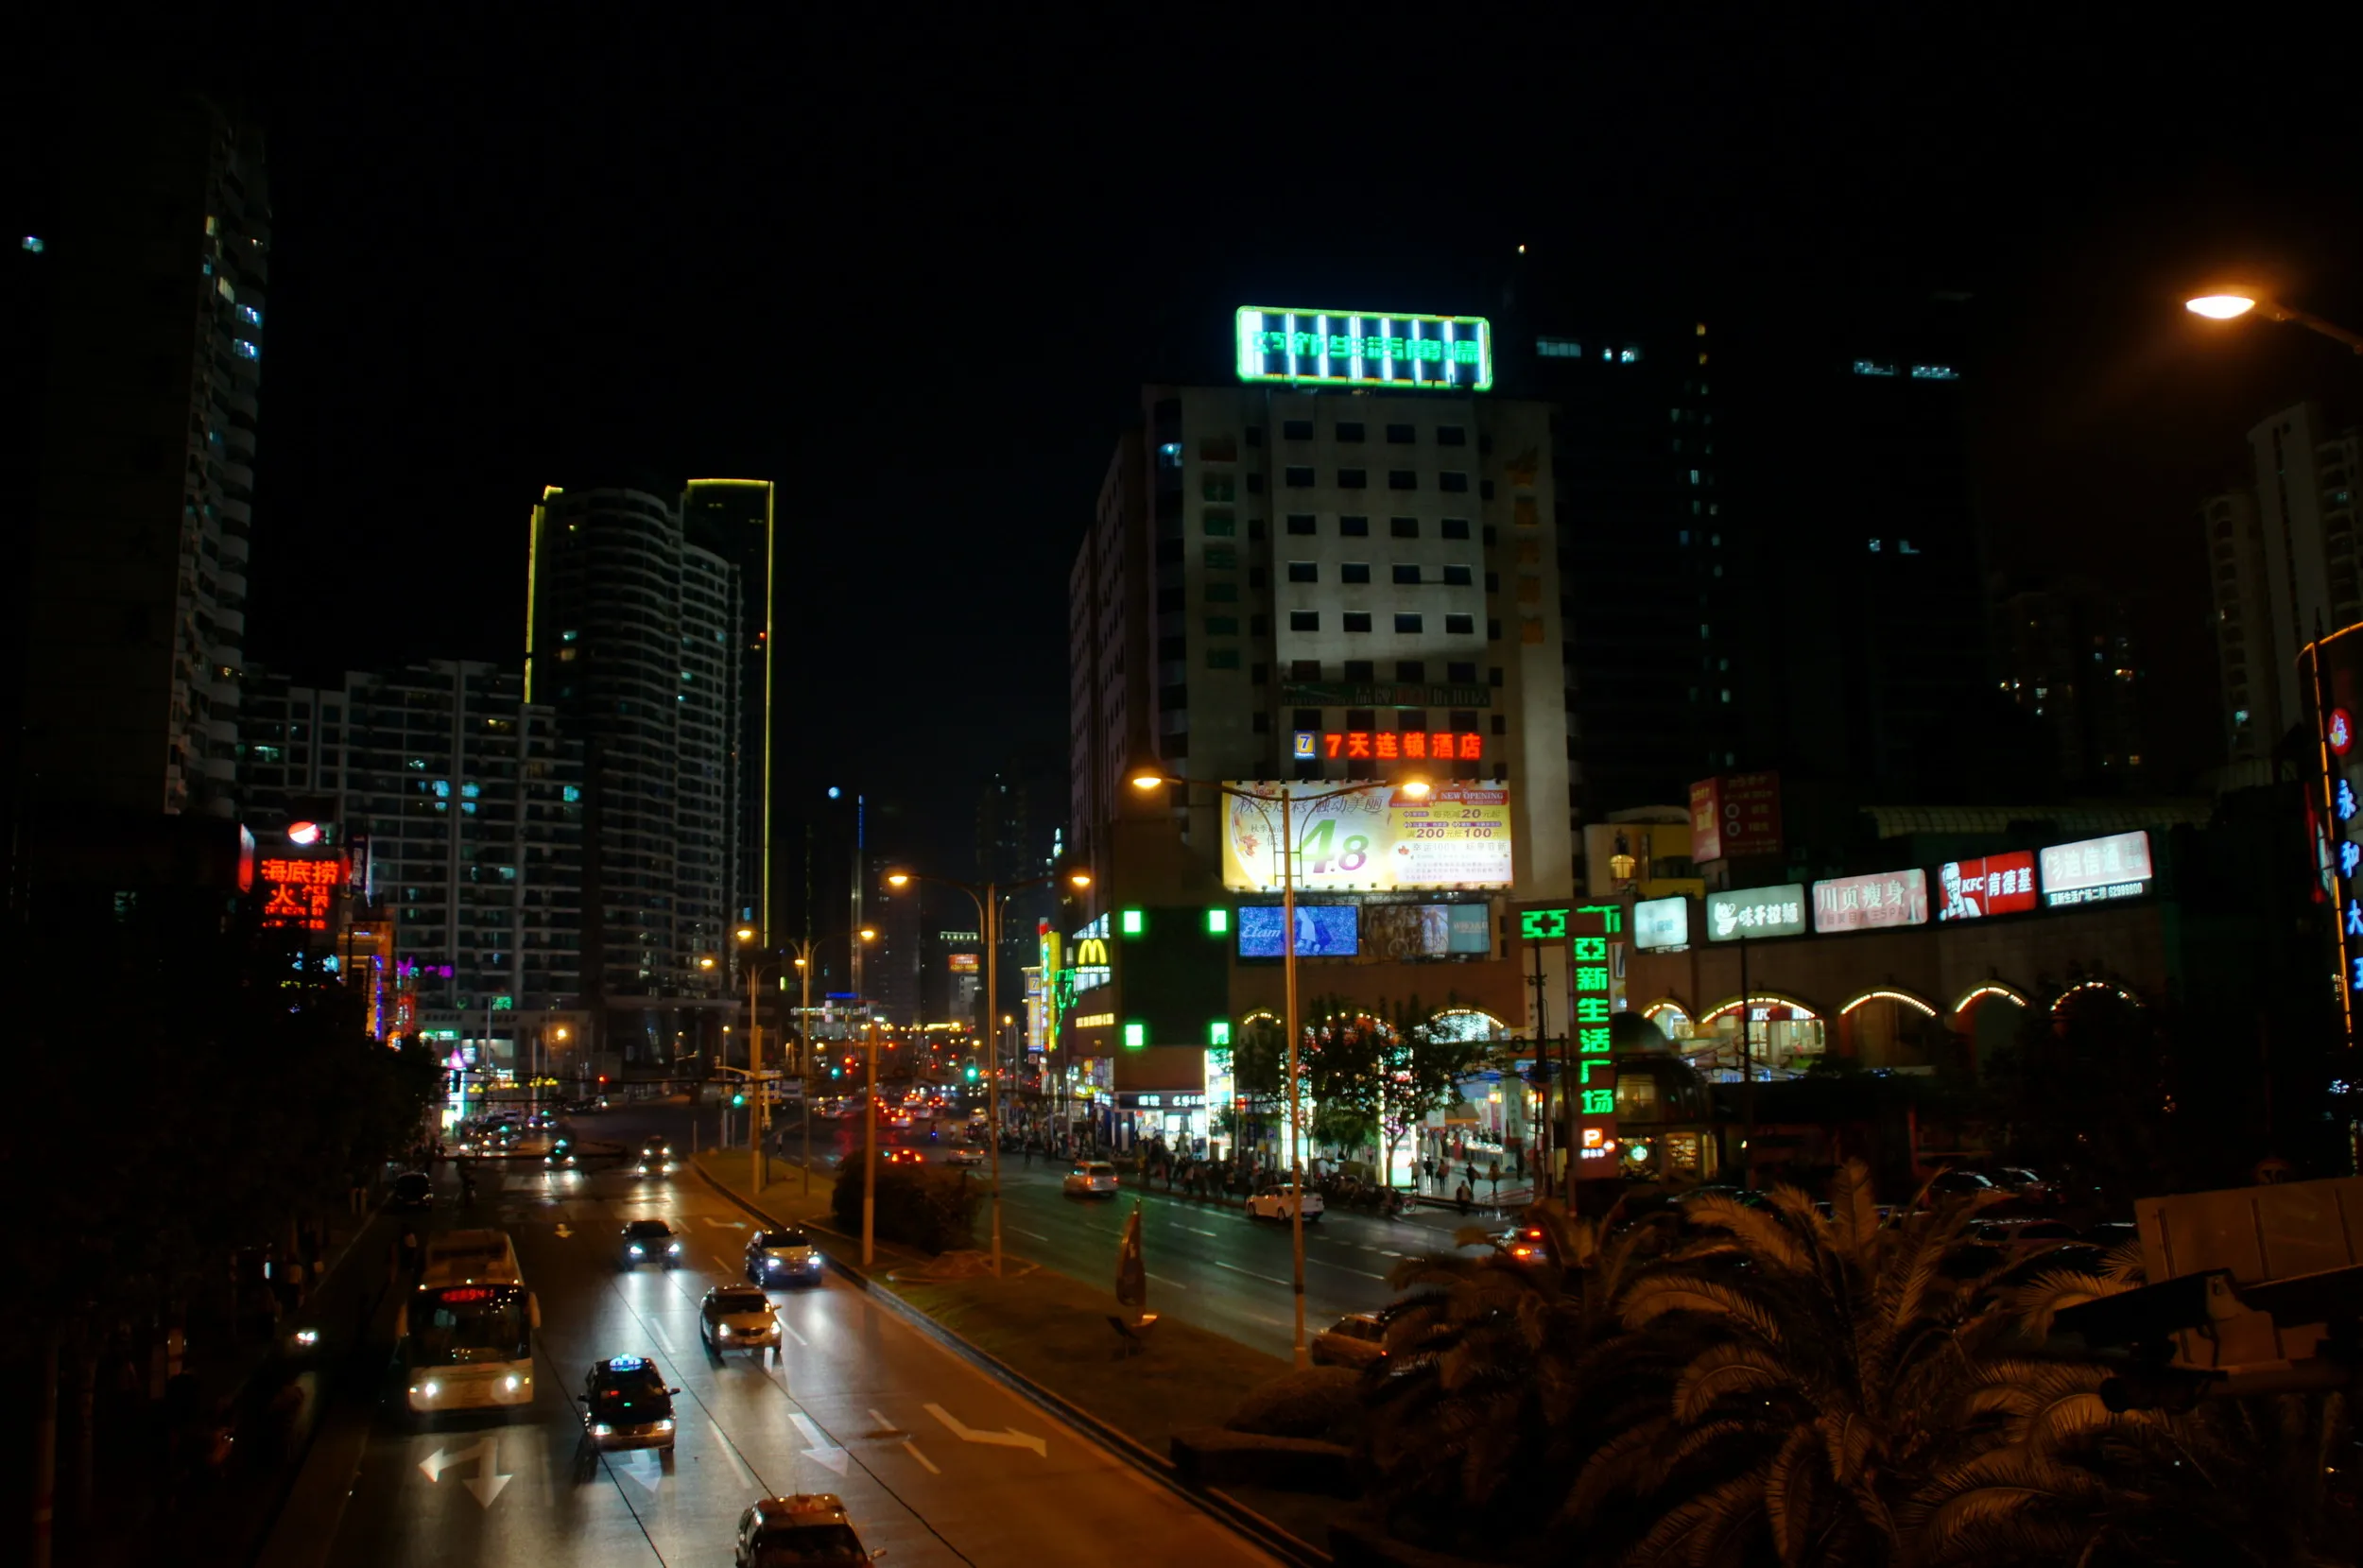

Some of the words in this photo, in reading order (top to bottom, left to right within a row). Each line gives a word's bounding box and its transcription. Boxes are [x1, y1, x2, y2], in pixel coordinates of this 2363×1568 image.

[1324, 732, 1481, 759] 7天连锁酒店
[1441, 791, 1461, 801] NEW
[1463, 791, 1504, 800] OPENING
[261, 857, 339, 885] 海底捞
[1961, 876, 1985, 893] KFC
[1988, 867, 2033, 897] 肯德基
[268, 884, 331, 908] 火锅
[1241, 924, 1282, 939] Etam
[1751, 1008, 1771, 1021] KFC
[1583, 1129, 1600, 1146] P
